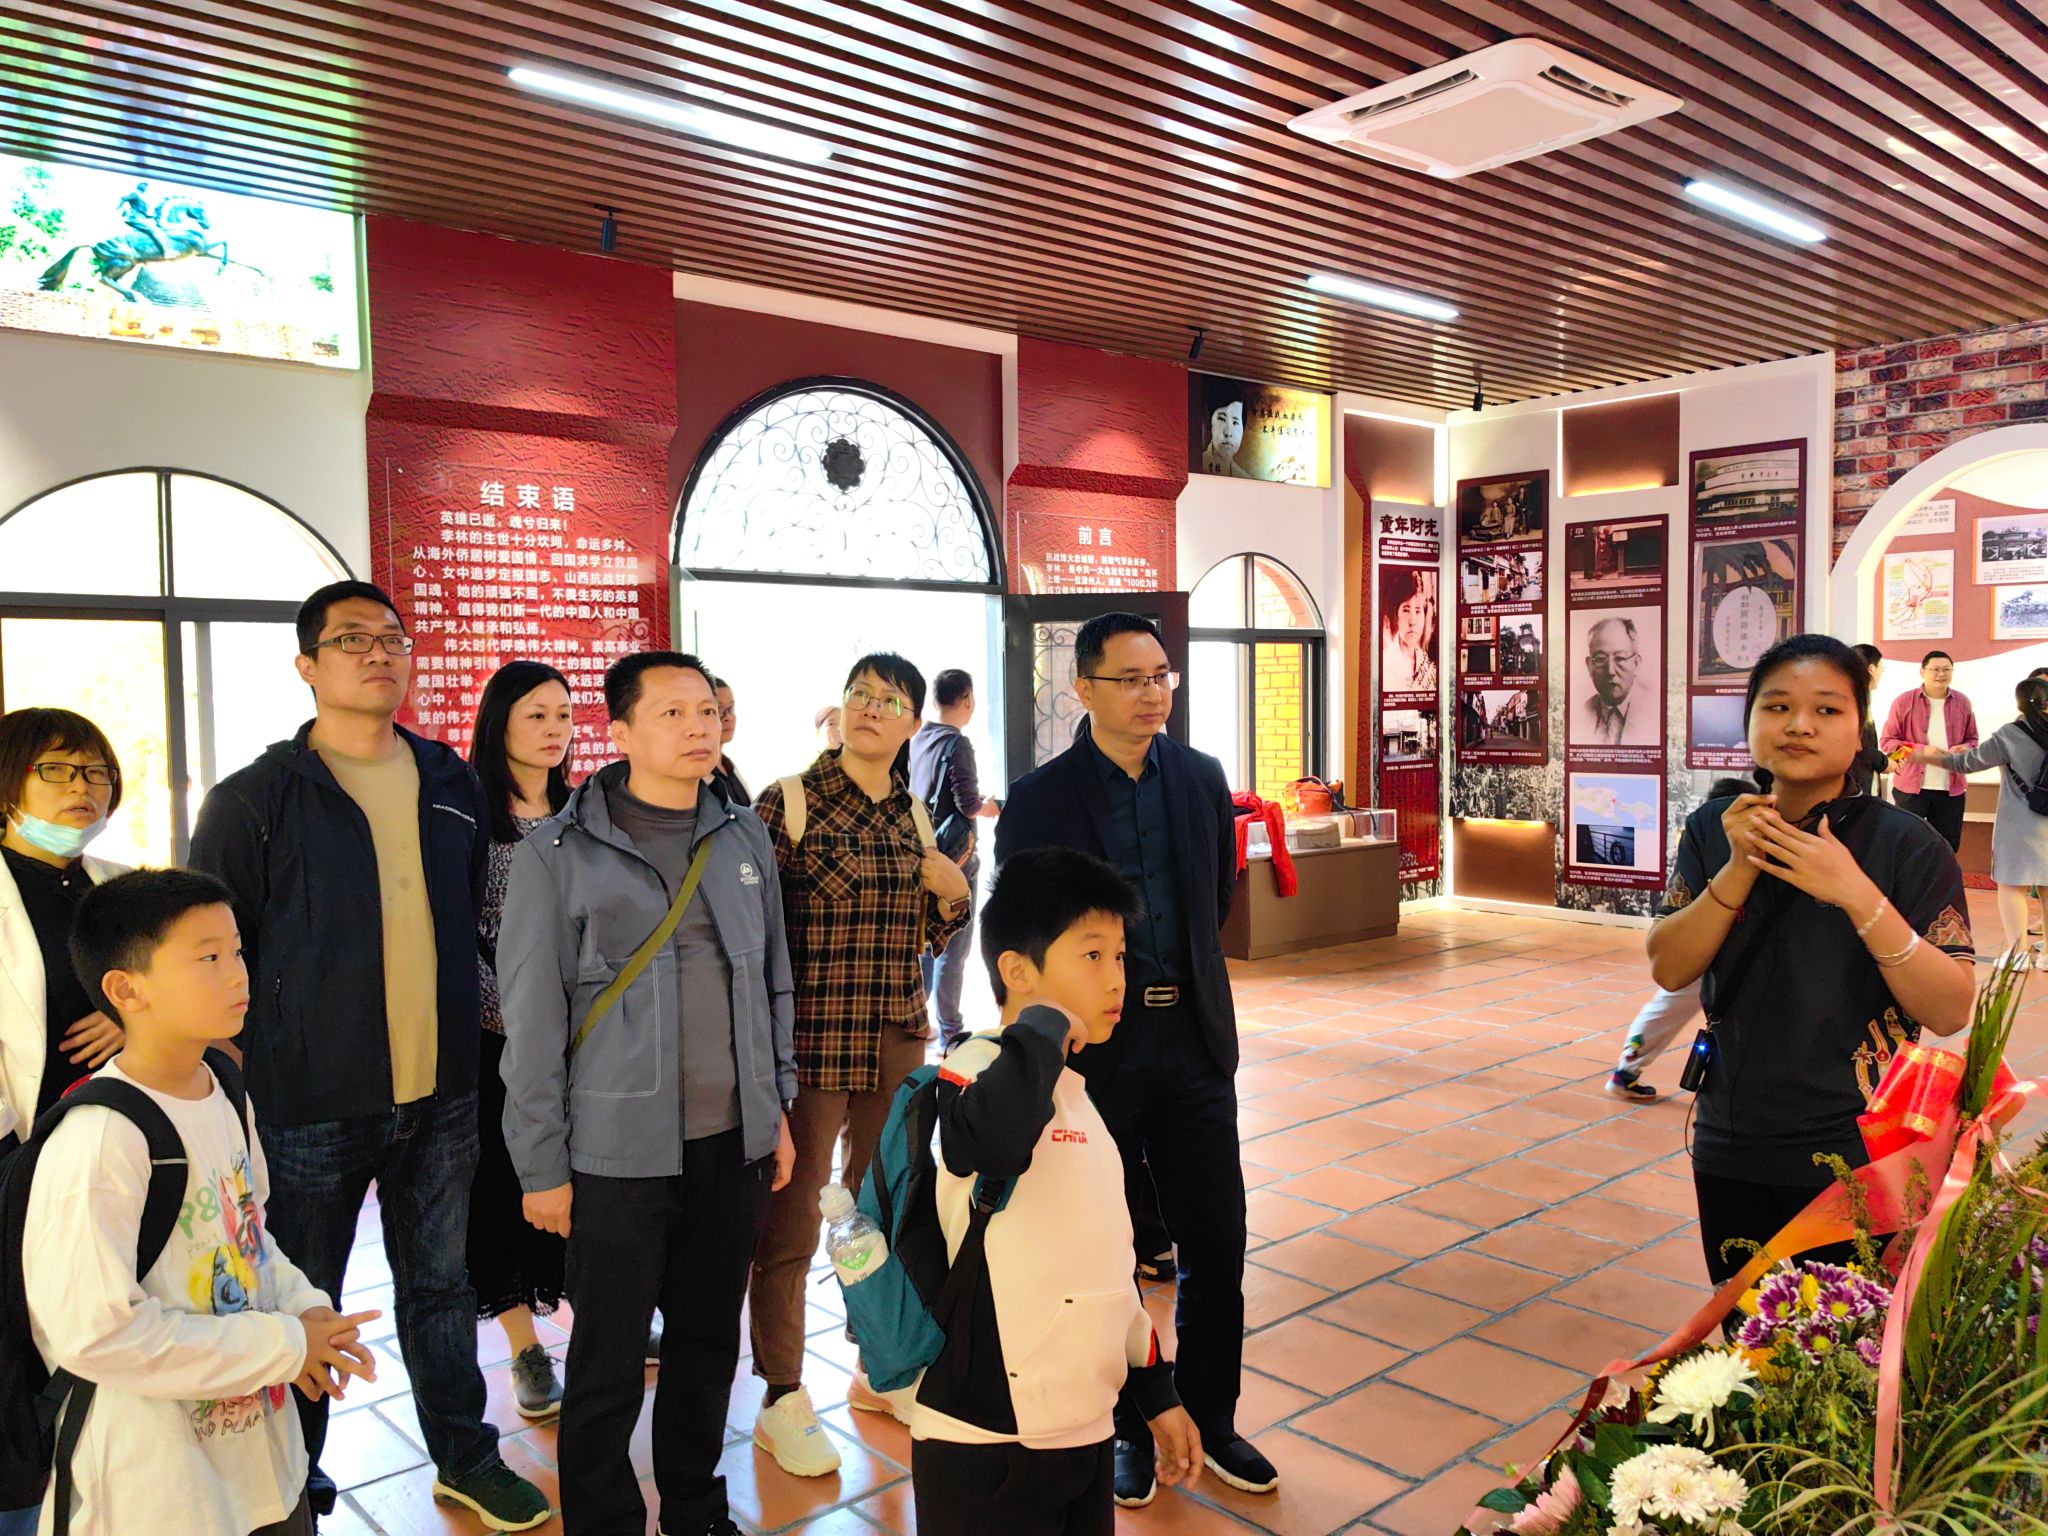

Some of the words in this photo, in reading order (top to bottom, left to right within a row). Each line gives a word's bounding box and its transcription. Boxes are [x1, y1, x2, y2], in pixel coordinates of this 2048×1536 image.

[480, 481, 575, 512] 结束语
[440, 511, 567, 531] 英雄已逝，魂兮归来！
[1380, 514, 1439, 537] 童年时光
[441, 529, 632, 552] 李林的生世十分坎坷，命运多舛。
[1078, 526, 1112, 546] 前言
[413, 545, 638, 569] 从海外侨居树爱国情、回国求学立救国
[414, 583, 638, 603] 国魂，她的顽强不屈，不畏生死的英勇
[415, 601, 639, 619] 精神，值得我们新一代的中国人和中国
[415, 620, 546, 635] 共产党人继承和弘扬。
[444, 638, 640, 653] 伟大时代呼唤伟大精神，崇高事业
[418, 710, 474, 725] 族的伟大
